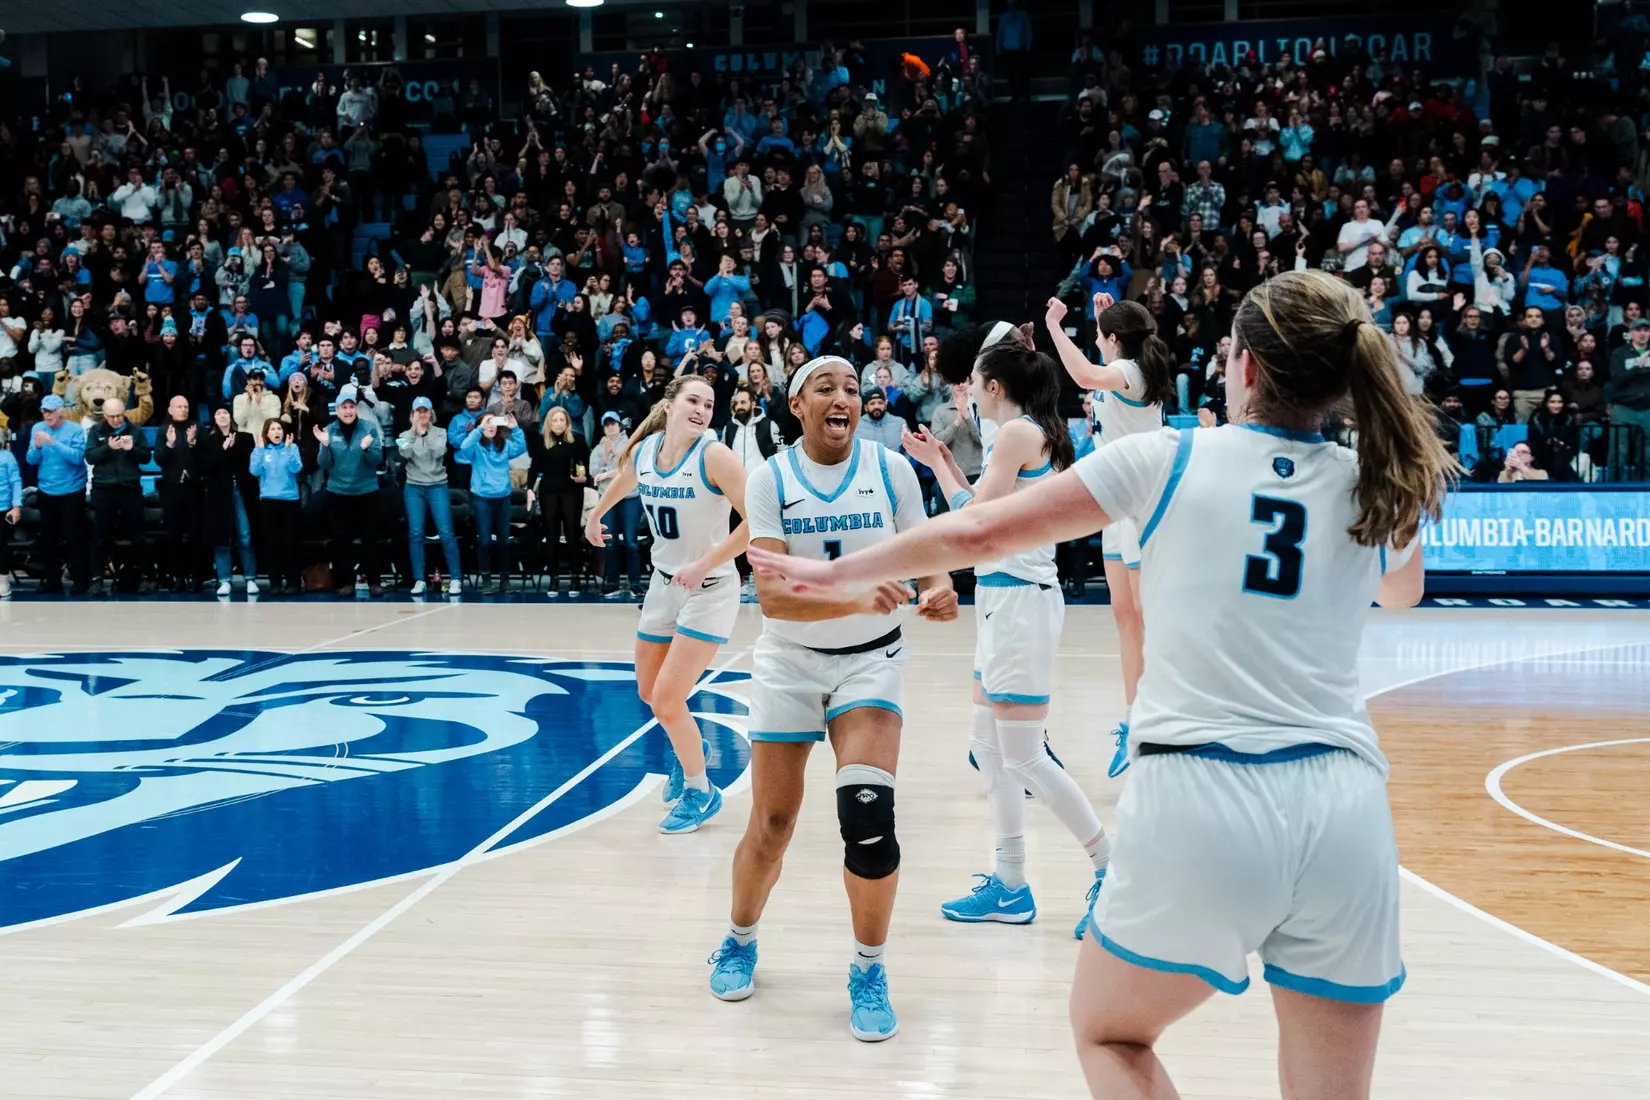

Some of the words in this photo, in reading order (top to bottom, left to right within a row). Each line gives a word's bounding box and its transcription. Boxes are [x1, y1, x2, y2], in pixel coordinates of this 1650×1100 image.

[1142, 32, 1432, 67] #ROARLIOOAR
[637, 481, 696, 499] COLUMBIA
[645, 503, 681, 540] 10
[782, 512, 884, 535] COLUMBIA
[1421, 518, 1650, 547] LUMBIA-BARNARD
[1241, 492, 1308, 600] 3
